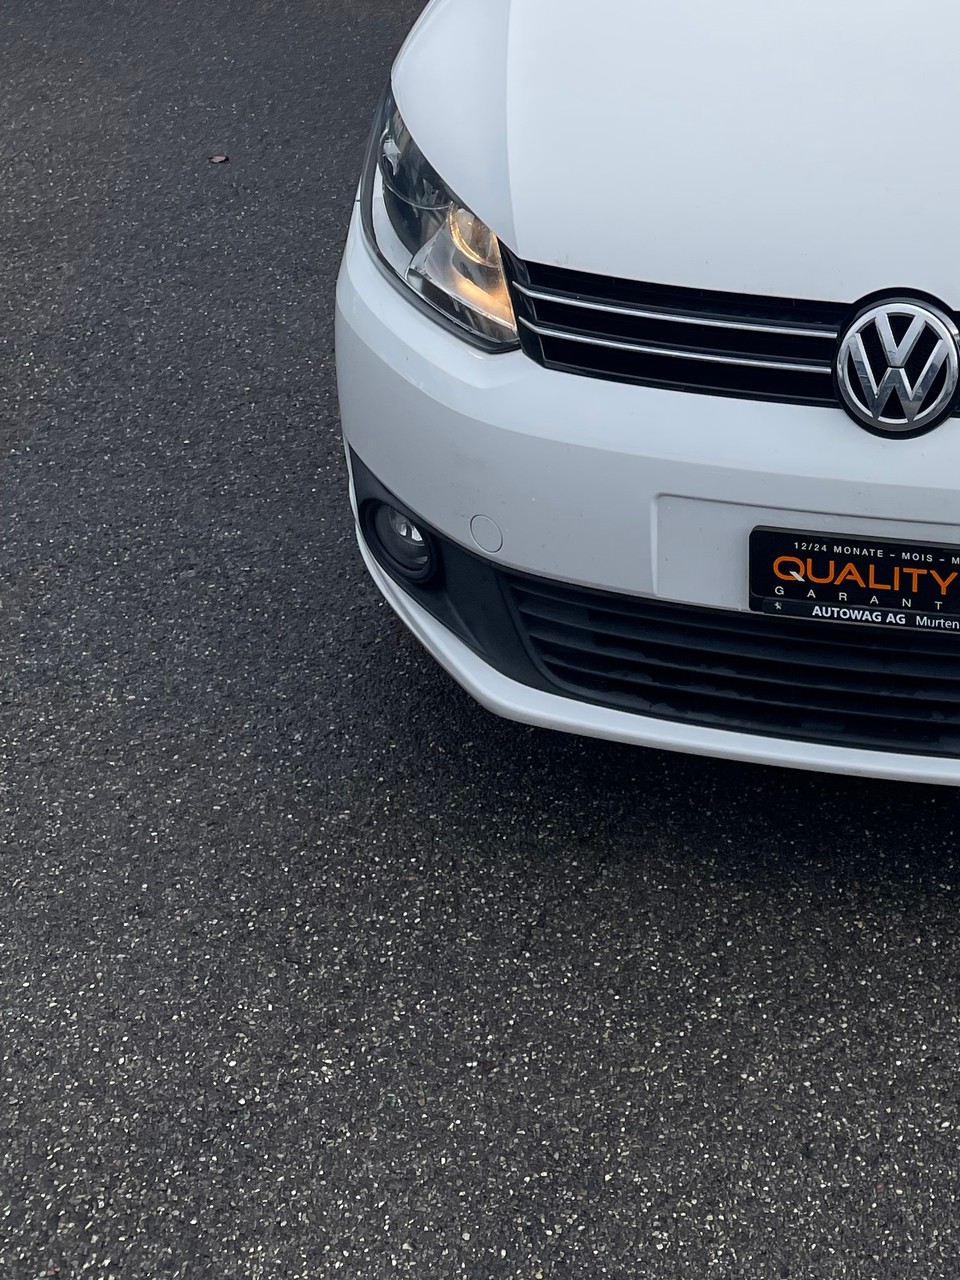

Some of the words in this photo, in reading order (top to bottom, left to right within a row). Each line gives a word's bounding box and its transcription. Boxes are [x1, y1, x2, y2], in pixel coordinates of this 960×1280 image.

[793, 541, 828, 553] 12/24
[833, 545, 884, 558] MONATE
[901, 551, 933, 563] MOIS
[772, 555, 959, 596] QUALITY
[811, 605, 882, 623] AUTOWAG
[886, 612, 906, 625] AG
[915, 615, 960, 630] Murten
